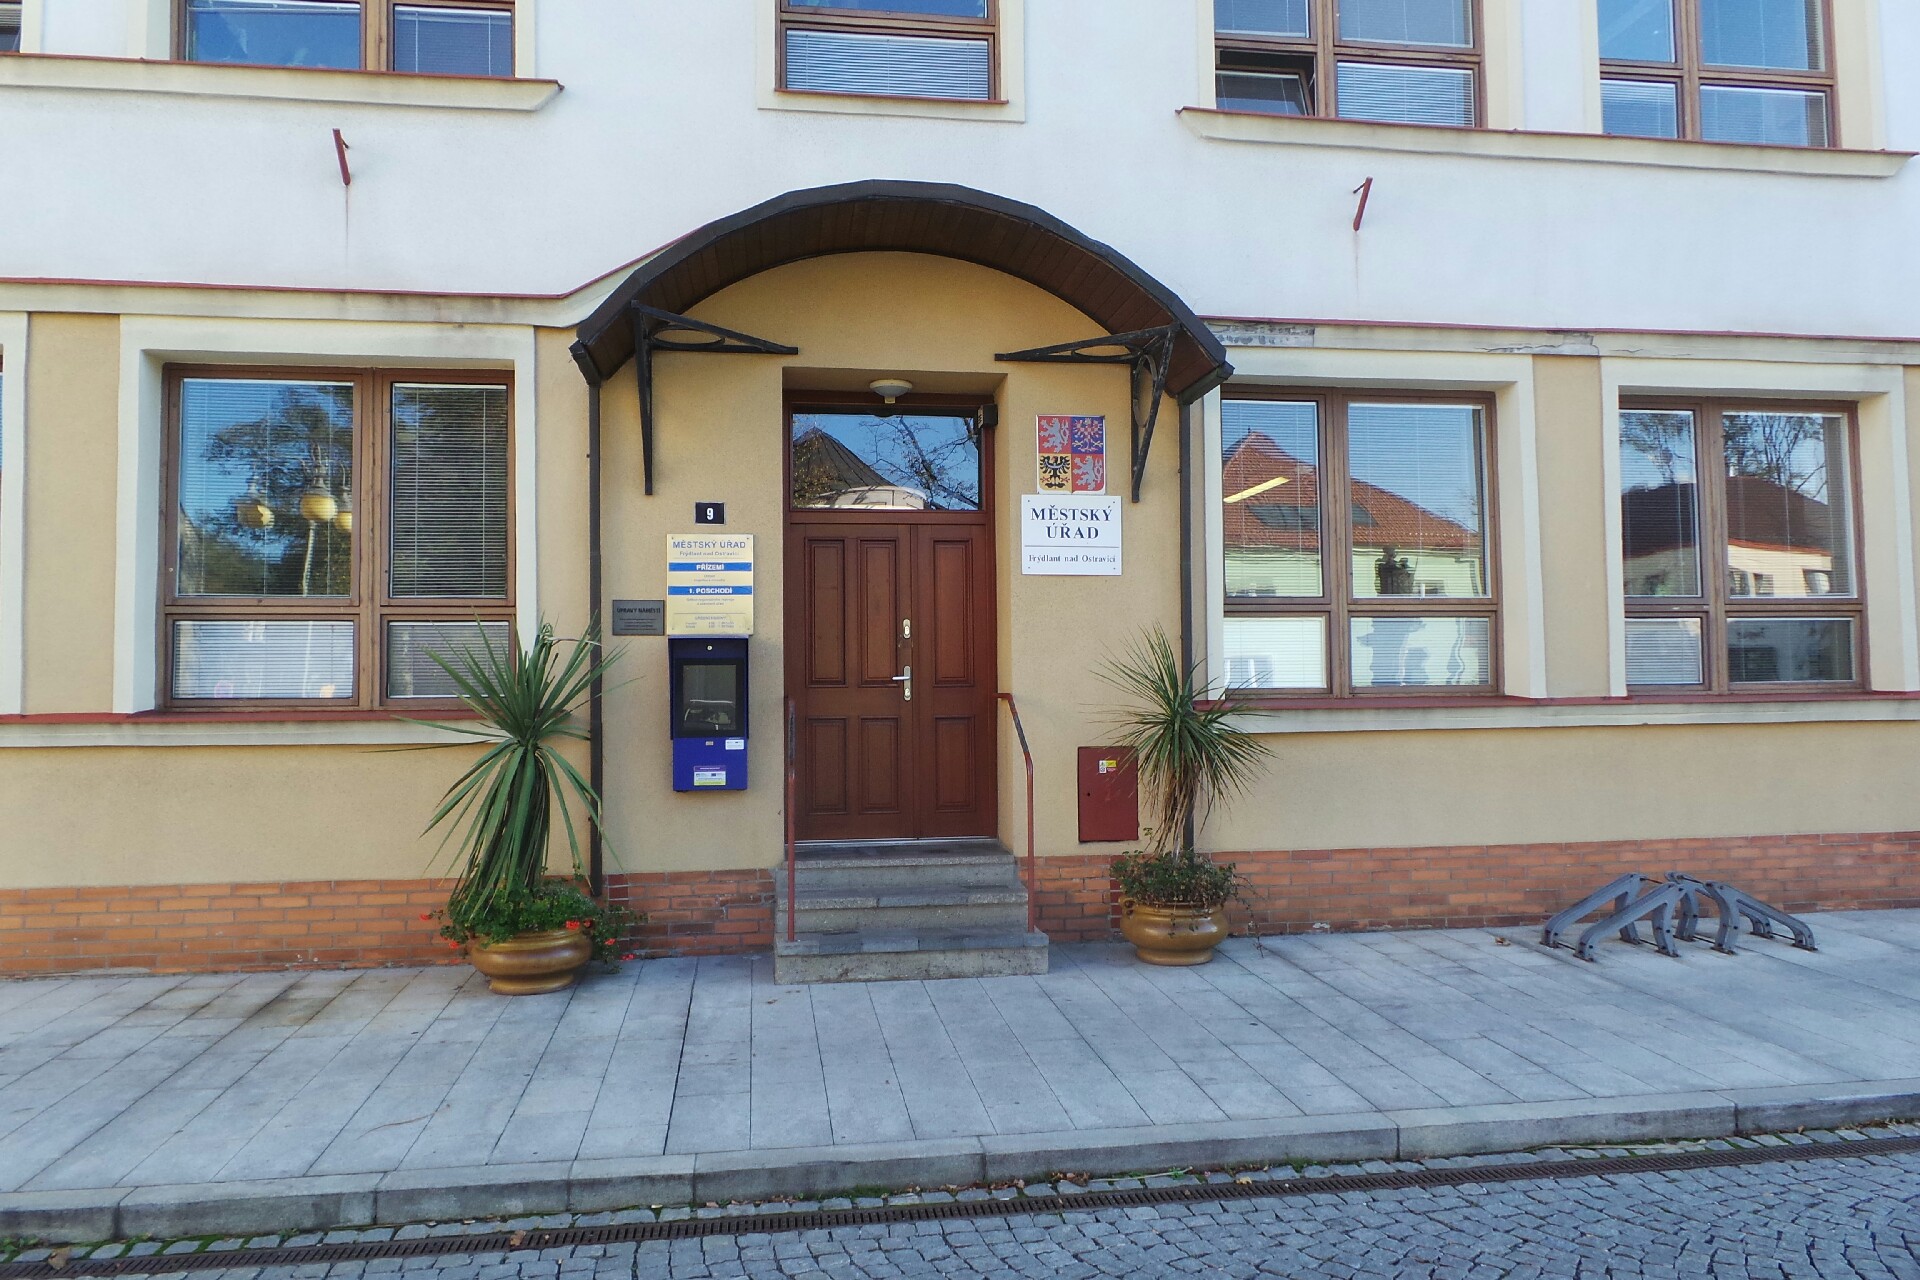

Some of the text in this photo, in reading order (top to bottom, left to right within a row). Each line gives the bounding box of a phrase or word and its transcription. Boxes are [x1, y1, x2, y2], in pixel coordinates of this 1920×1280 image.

[707, 507, 714, 520] 9
[1030, 505, 1112, 521] MĚSTSKÝ
[1046, 523, 1099, 539] ÚŘAD
[672, 539, 717, 549] MĚSTSKÝ
[1029, 554, 1117, 564] Frýdlant nad Ostravici
[696, 563, 725, 571] PŘÍZEMÍ
